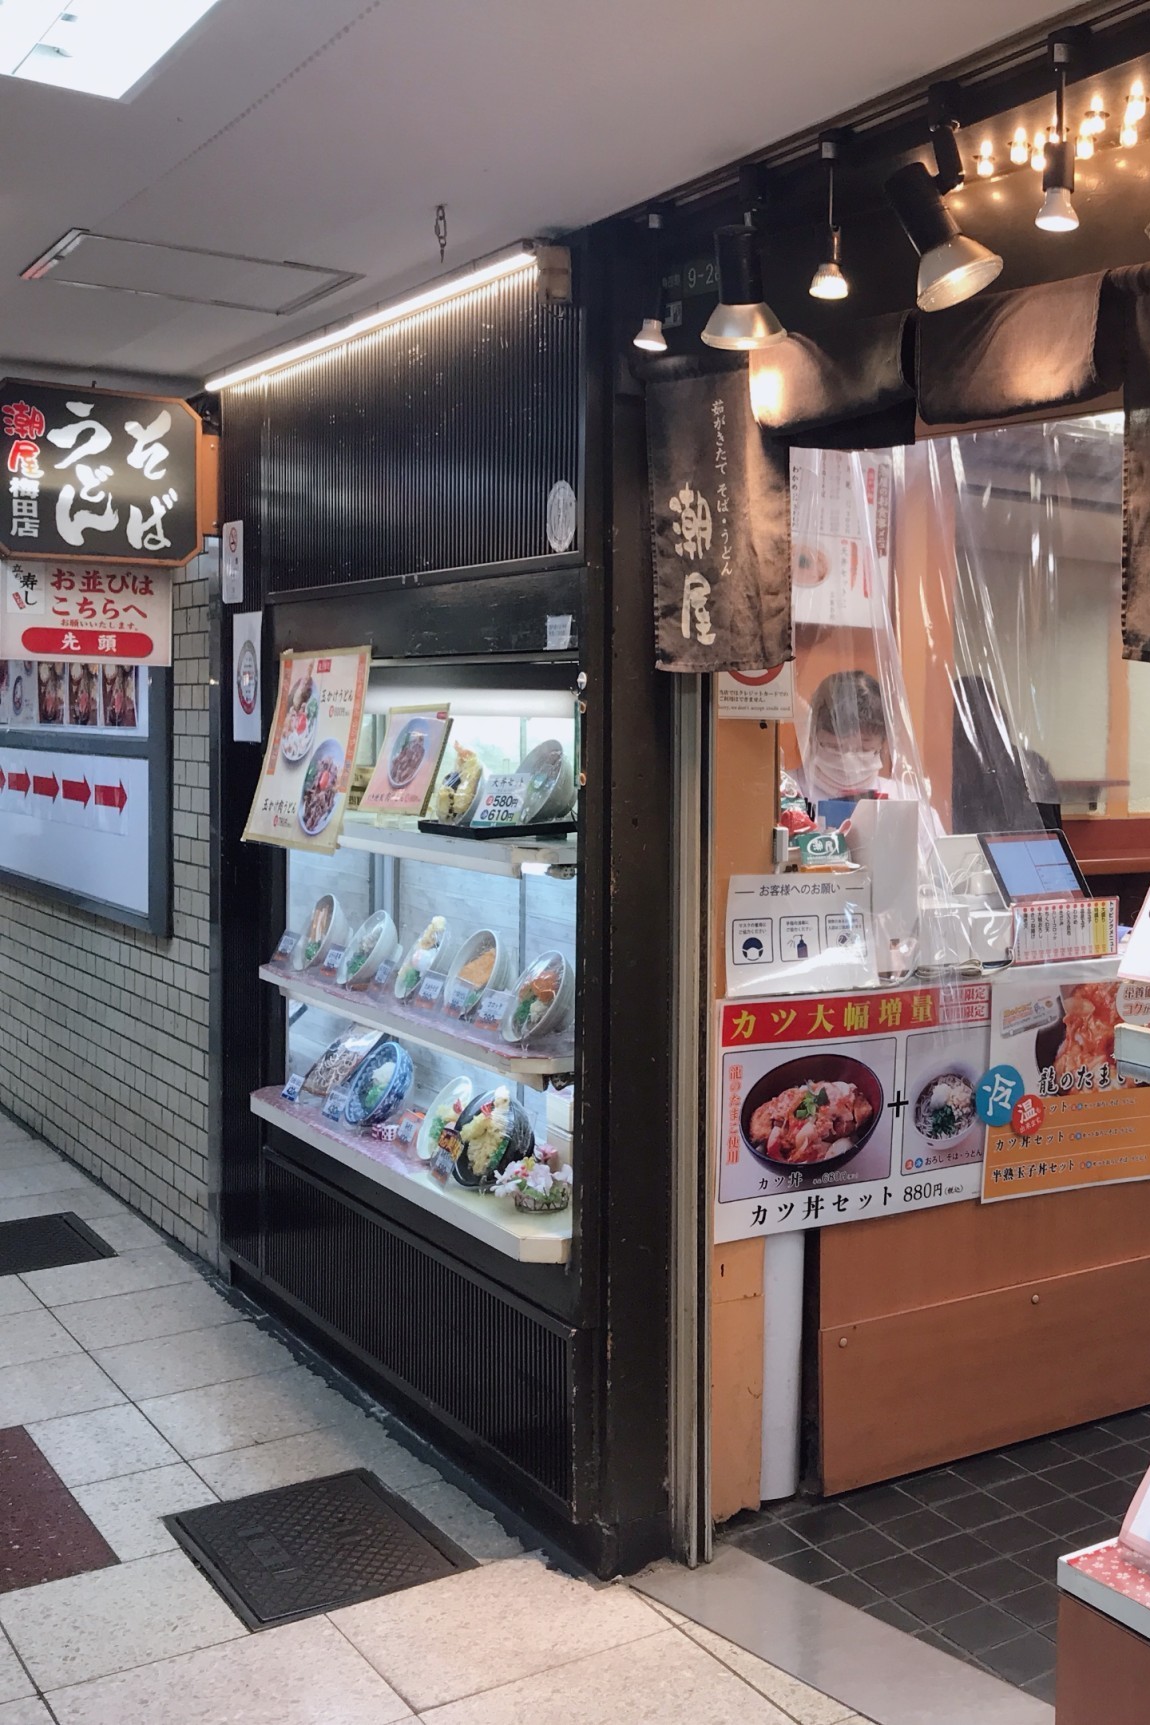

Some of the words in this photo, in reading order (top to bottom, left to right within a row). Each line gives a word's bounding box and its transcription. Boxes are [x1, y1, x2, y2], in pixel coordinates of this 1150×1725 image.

[47, 401, 119, 546] うどん
[124, 410, 178, 550] そば
[50, 568, 154, 596] お並びは
[52, 596, 147, 619] こちらへ
[60, 631, 117, 652] 先頭
[759, 882, 841, 897] お客様へのお願い
[729, 994, 934, 1041] カツ大幅増量
[982, 1073, 1016, 1117] 冷
[1037, 1063, 1146, 1096] 龍のたま
[758, 1171, 803, 1191] カツ丼
[750, 1186, 893, 1228] カツ丼セット
